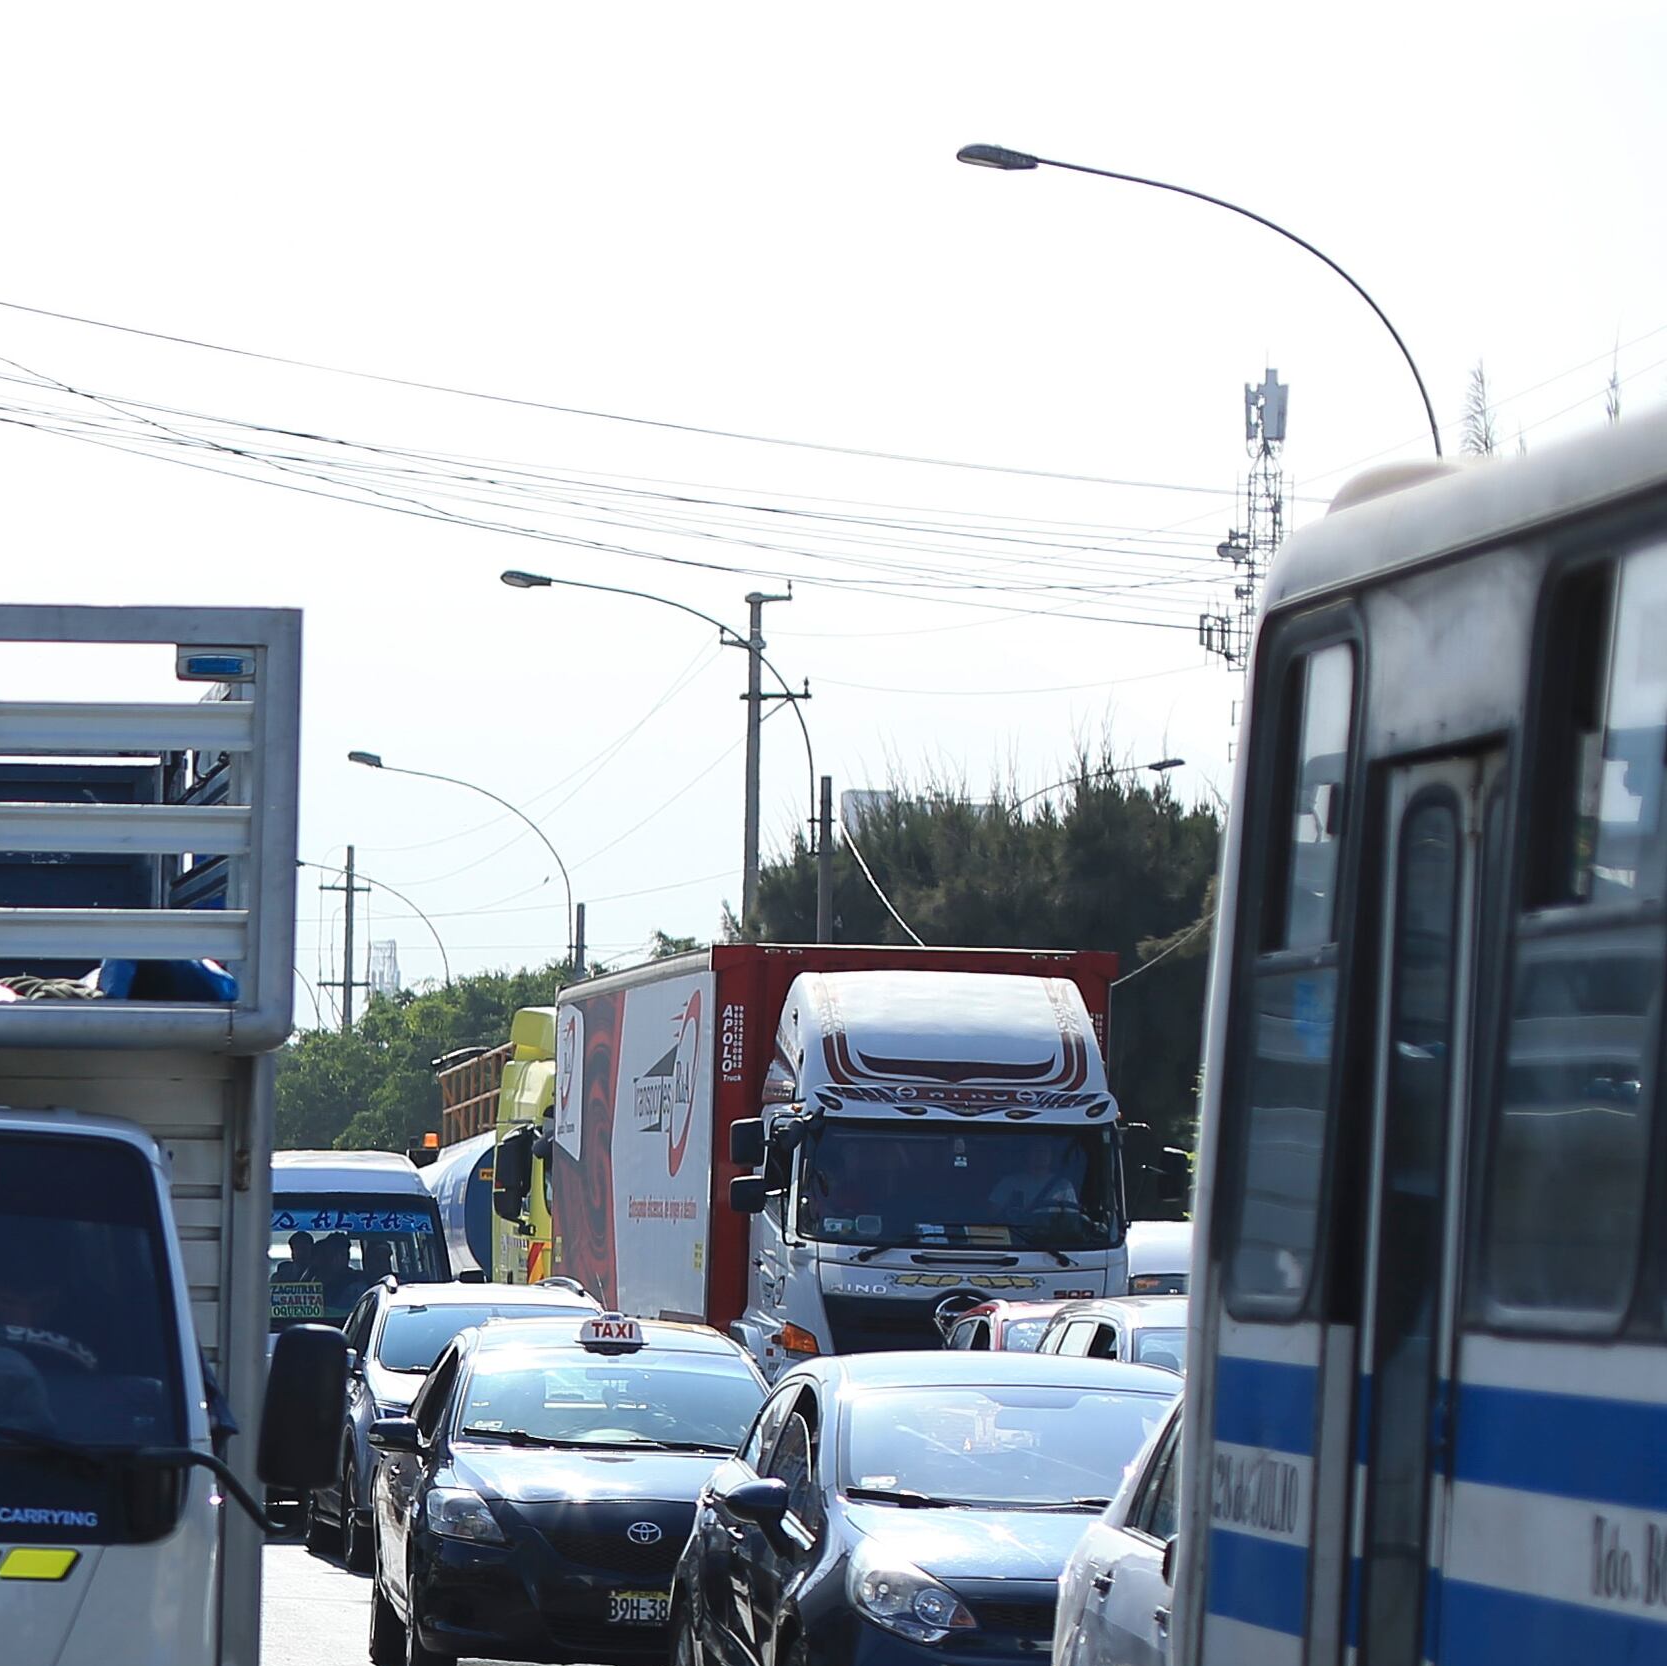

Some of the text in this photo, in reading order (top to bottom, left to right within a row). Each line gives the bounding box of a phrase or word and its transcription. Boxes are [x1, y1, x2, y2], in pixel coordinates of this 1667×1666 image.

[722, 1004, 733, 1073] APOLO
[829, 1283, 887, 1295] HINO
[273, 1305, 320, 1316] OQUENDO
[591, 1322, 633, 1339] TAXI
[608, 1597, 668, 1620] B9H-38
